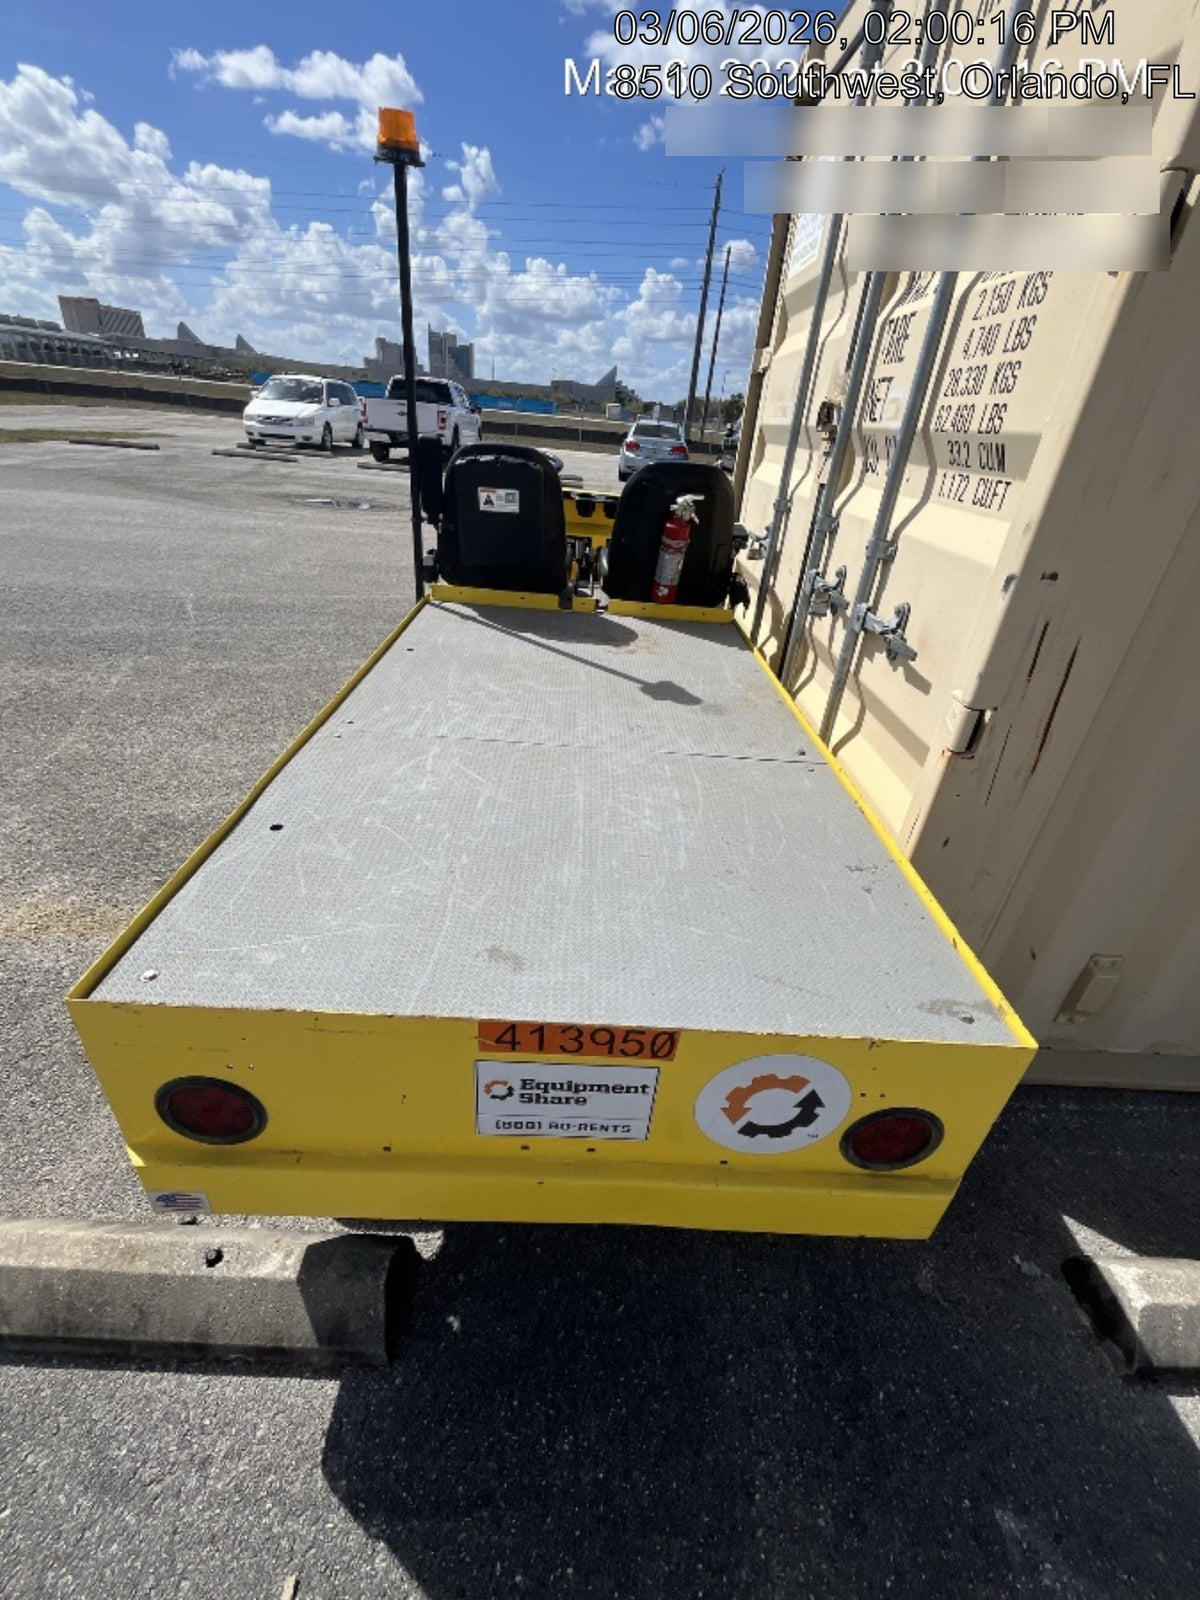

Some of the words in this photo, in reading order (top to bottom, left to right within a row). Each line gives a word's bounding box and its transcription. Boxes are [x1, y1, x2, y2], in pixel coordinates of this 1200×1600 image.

[1016, 271, 1054, 310] KGS
[1002, 314, 1038, 354] LBS
[988, 360, 1022, 395] KGS
[977, 403, 1008, 434] LBS
[494, 1023, 677, 1059] 413950
[519, 1092, 588, 1106] Share
[520, 1078, 650, 1095] Equipment
